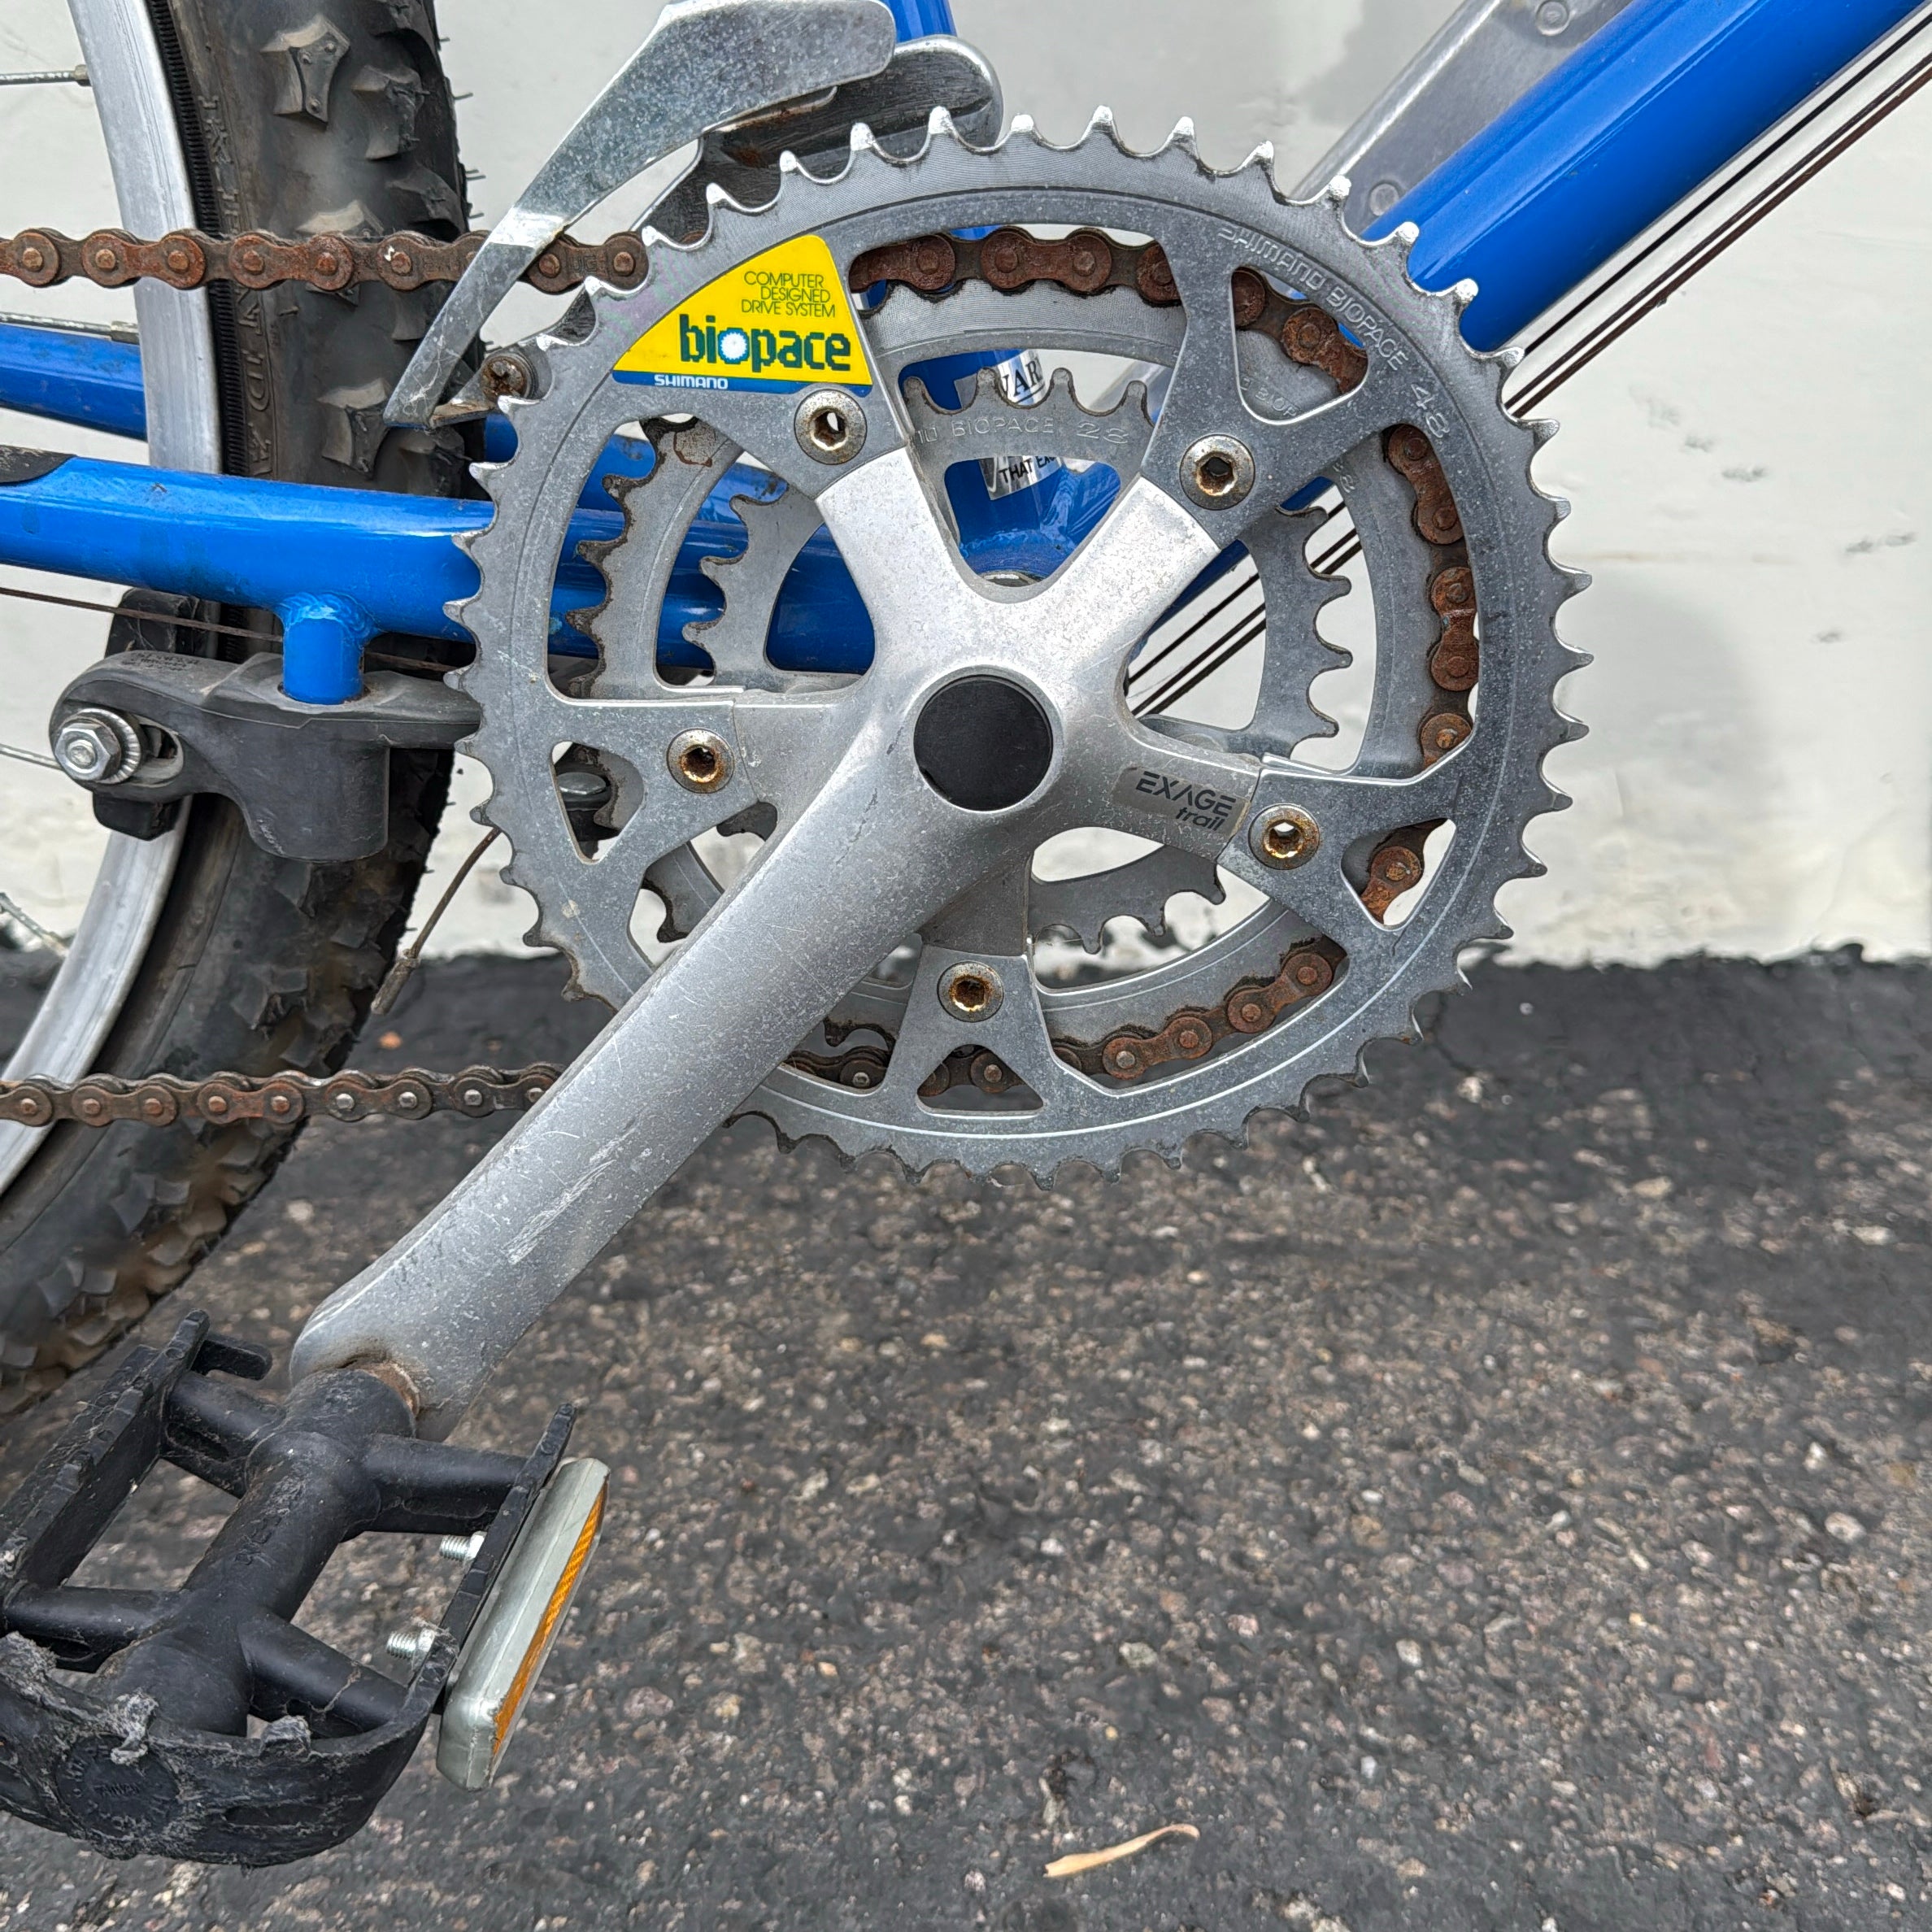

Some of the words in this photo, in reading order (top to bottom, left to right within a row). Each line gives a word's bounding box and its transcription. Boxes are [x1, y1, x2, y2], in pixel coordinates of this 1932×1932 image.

[744, 271, 824, 288] COMPUTER
[760, 286, 830, 304] DESIGNED
[1218, 224, 1326, 289] SHIMANO
[1326, 288, 1408, 370] BIOPACE
[742, 299, 781, 315] DRIVE
[785, 302, 836, 318] SYSTEM
[679, 314, 851, 372] biopace
[654, 374, 729, 389] SHIMANO
[1410, 383, 1449, 437] 48
[951, 416, 1054, 437] BIOPACE
[1076, 421, 1129, 444] 28
[998, 458, 1033, 483] THAT
[1135, 771, 1237, 816] EXAGE
[1176, 807, 1225, 831] trail
